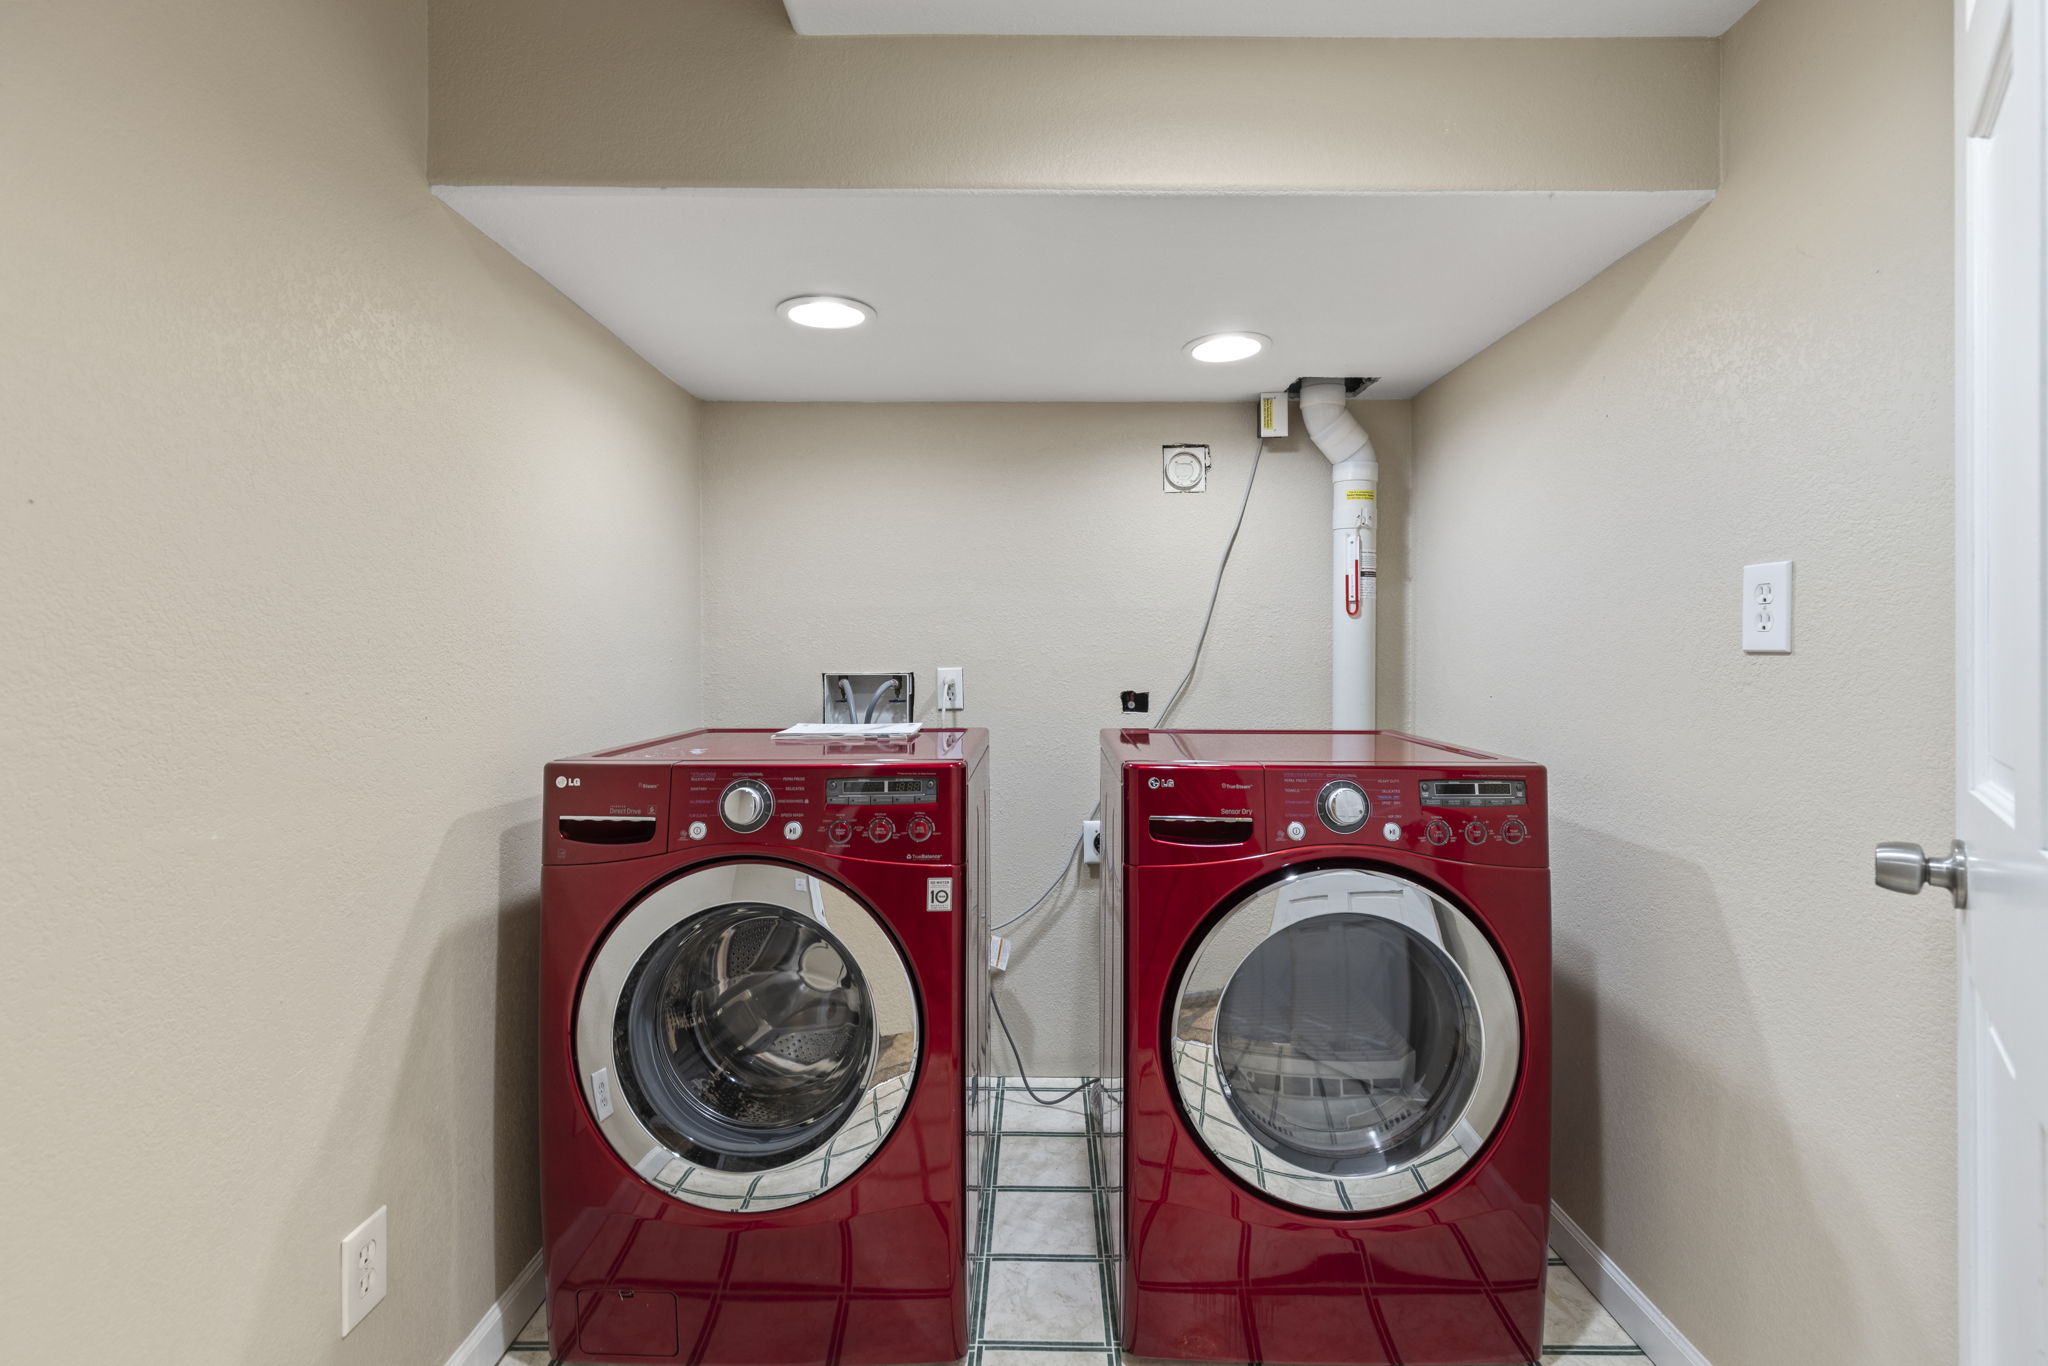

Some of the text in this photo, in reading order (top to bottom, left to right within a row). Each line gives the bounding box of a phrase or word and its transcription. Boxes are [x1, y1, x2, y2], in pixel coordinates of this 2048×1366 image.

[568, 778, 581, 786] LG
[1161, 779, 1174, 787] LG
[1241, 808, 1253, 816] Dry
[930, 890, 949, 904] 10
